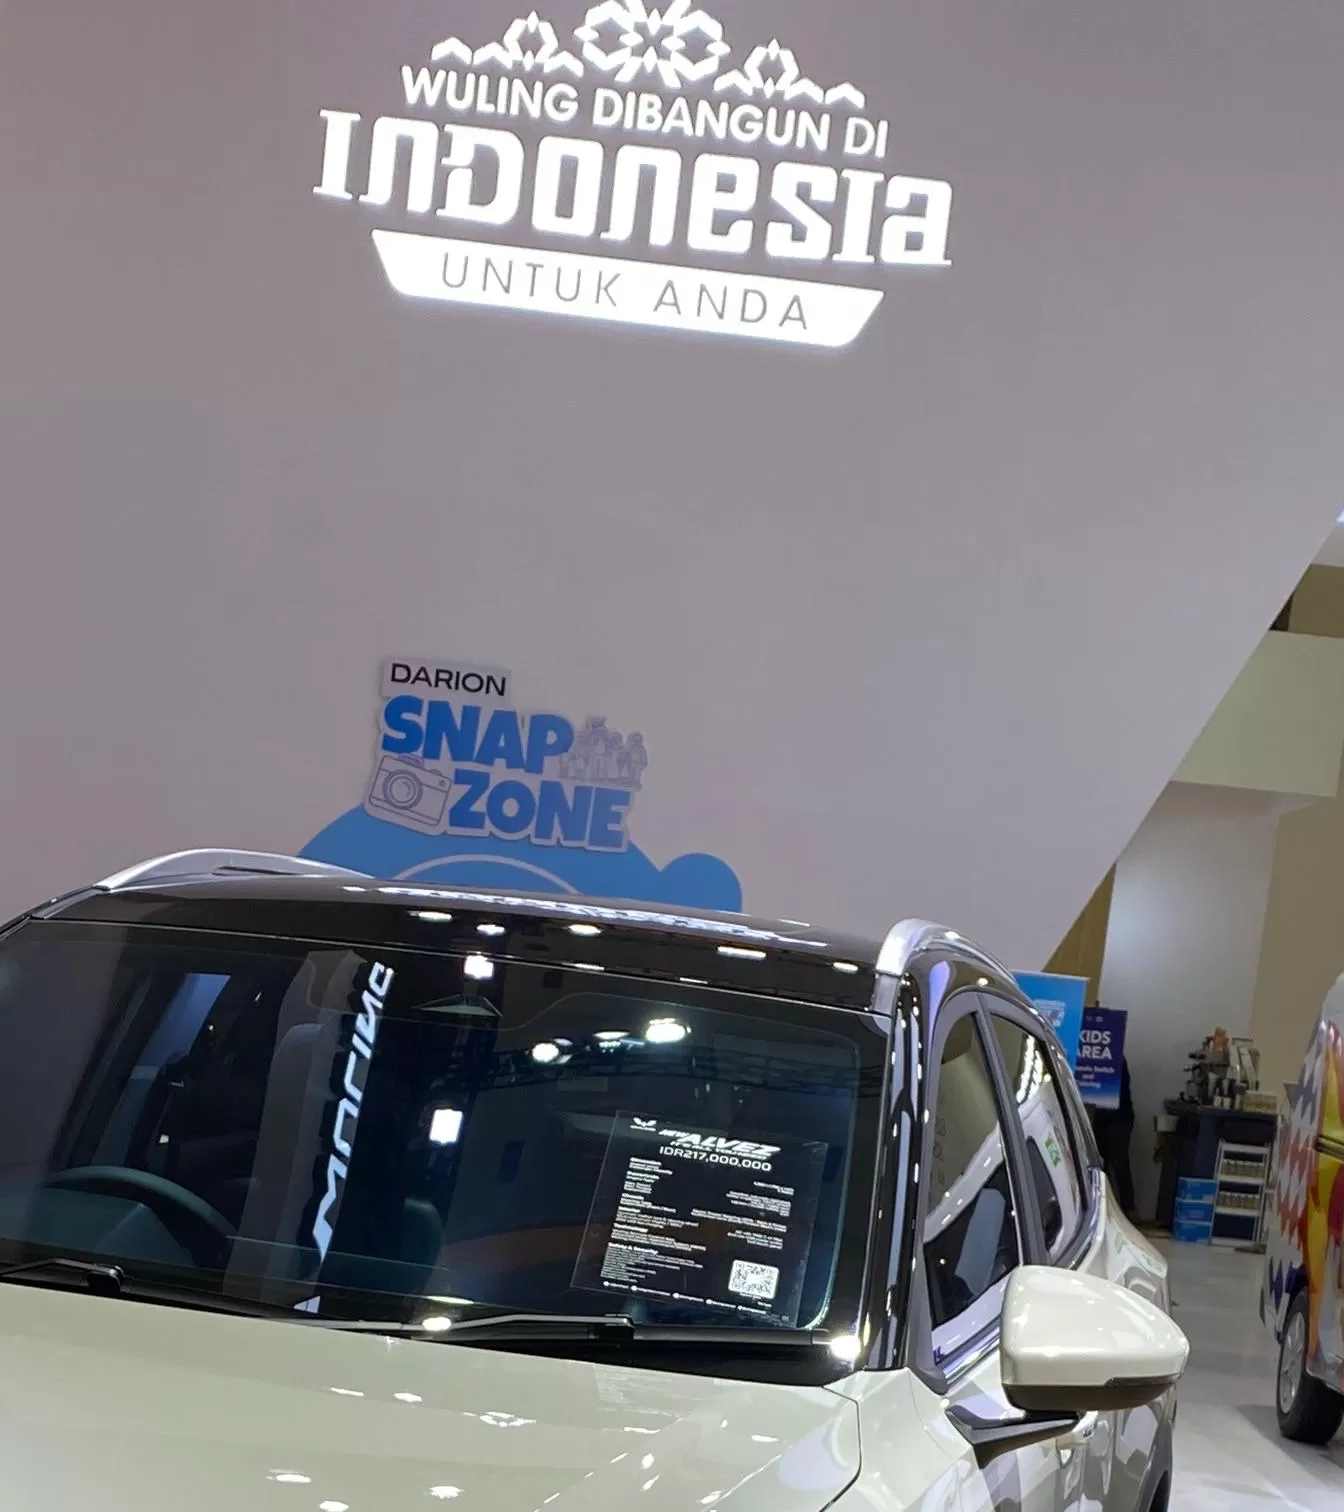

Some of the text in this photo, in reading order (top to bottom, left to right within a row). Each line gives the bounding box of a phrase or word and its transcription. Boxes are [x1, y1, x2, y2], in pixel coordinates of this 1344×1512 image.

[401, 65, 889, 158] WULING DIBANGUN DI
[442, 251, 810, 331] UNTUK ANDA
[390, 662, 508, 697] DARION
[380, 694, 576, 775] SNAP
[448, 767, 633, 849] ZONE
